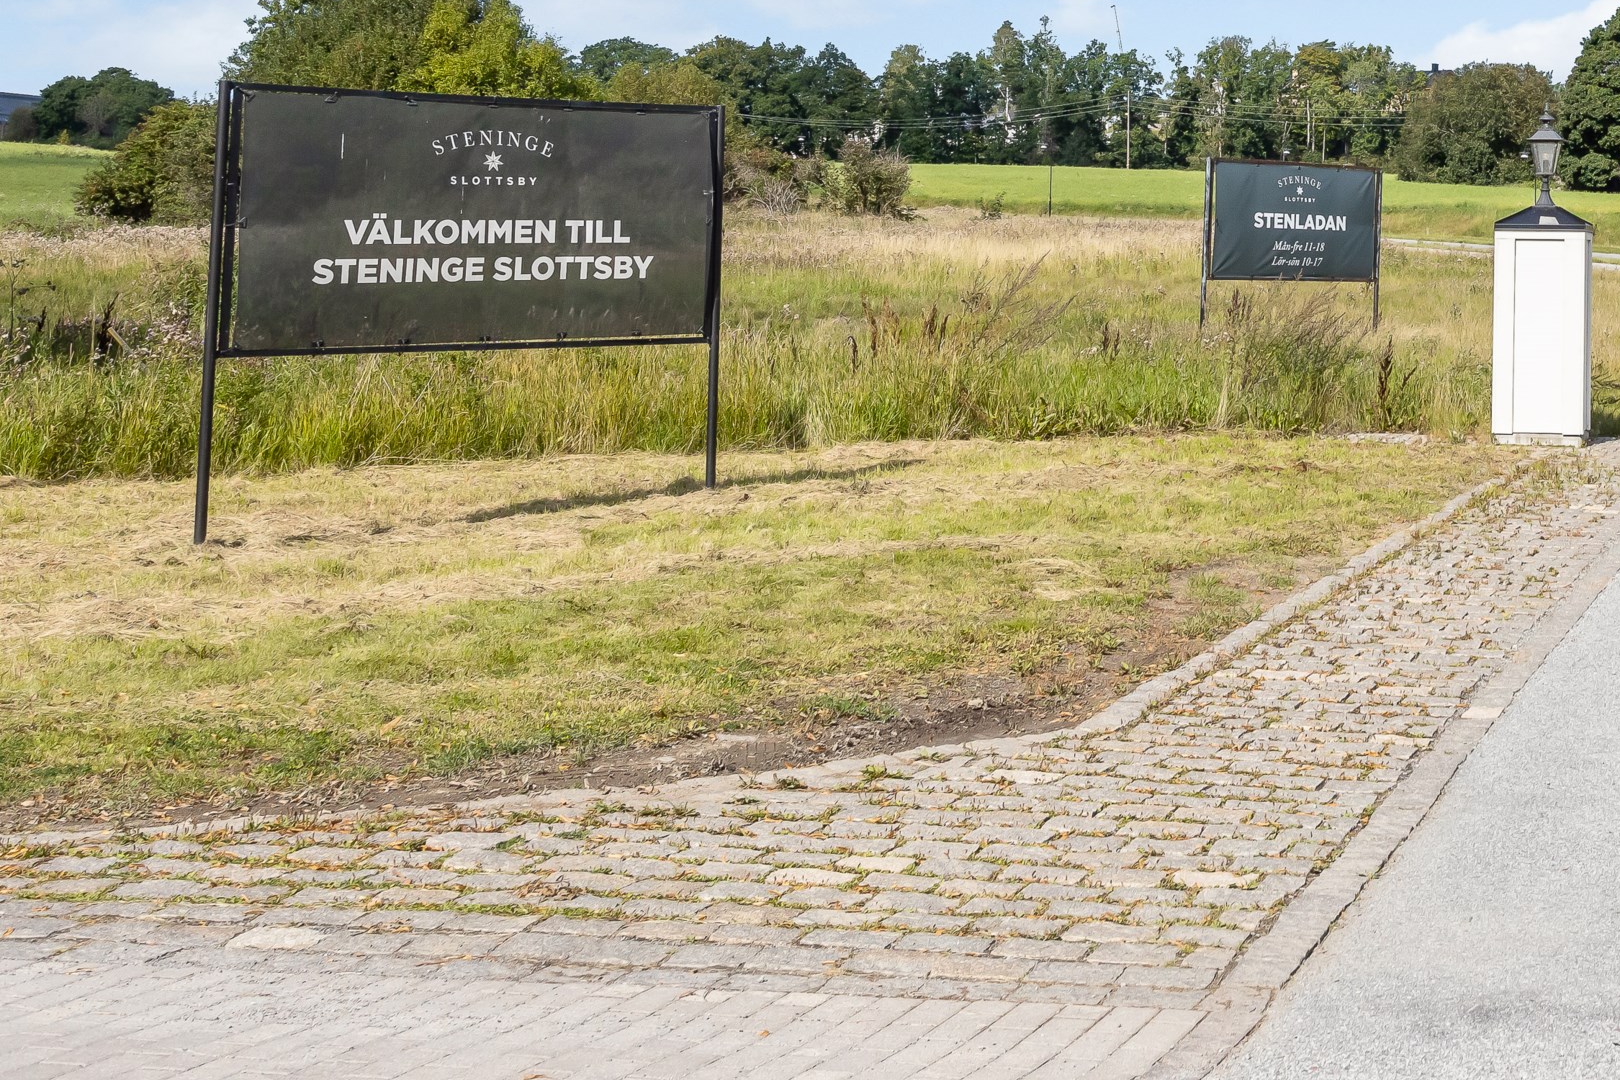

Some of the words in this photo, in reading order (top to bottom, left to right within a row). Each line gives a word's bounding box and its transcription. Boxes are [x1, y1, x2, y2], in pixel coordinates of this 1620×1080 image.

[431, 129, 554, 159] STENINGE
[450, 175, 538, 186] SLOTTSBY
[1277, 175, 1322, 190] STENINGE
[344, 213, 557, 245] VÄLKOMMEN
[565, 219, 631, 244] TILL
[1253, 212, 1347, 232] STENLADAN
[1272, 240, 1303, 254] Mån-fre
[1304, 241, 1326, 252] 11-18
[1271, 255, 1301, 267] Lör-sön
[1301, 256, 1324, 267] 10-17
[311, 256, 485, 285] STENINGE
[492, 255, 655, 282] SLOTTSBY
